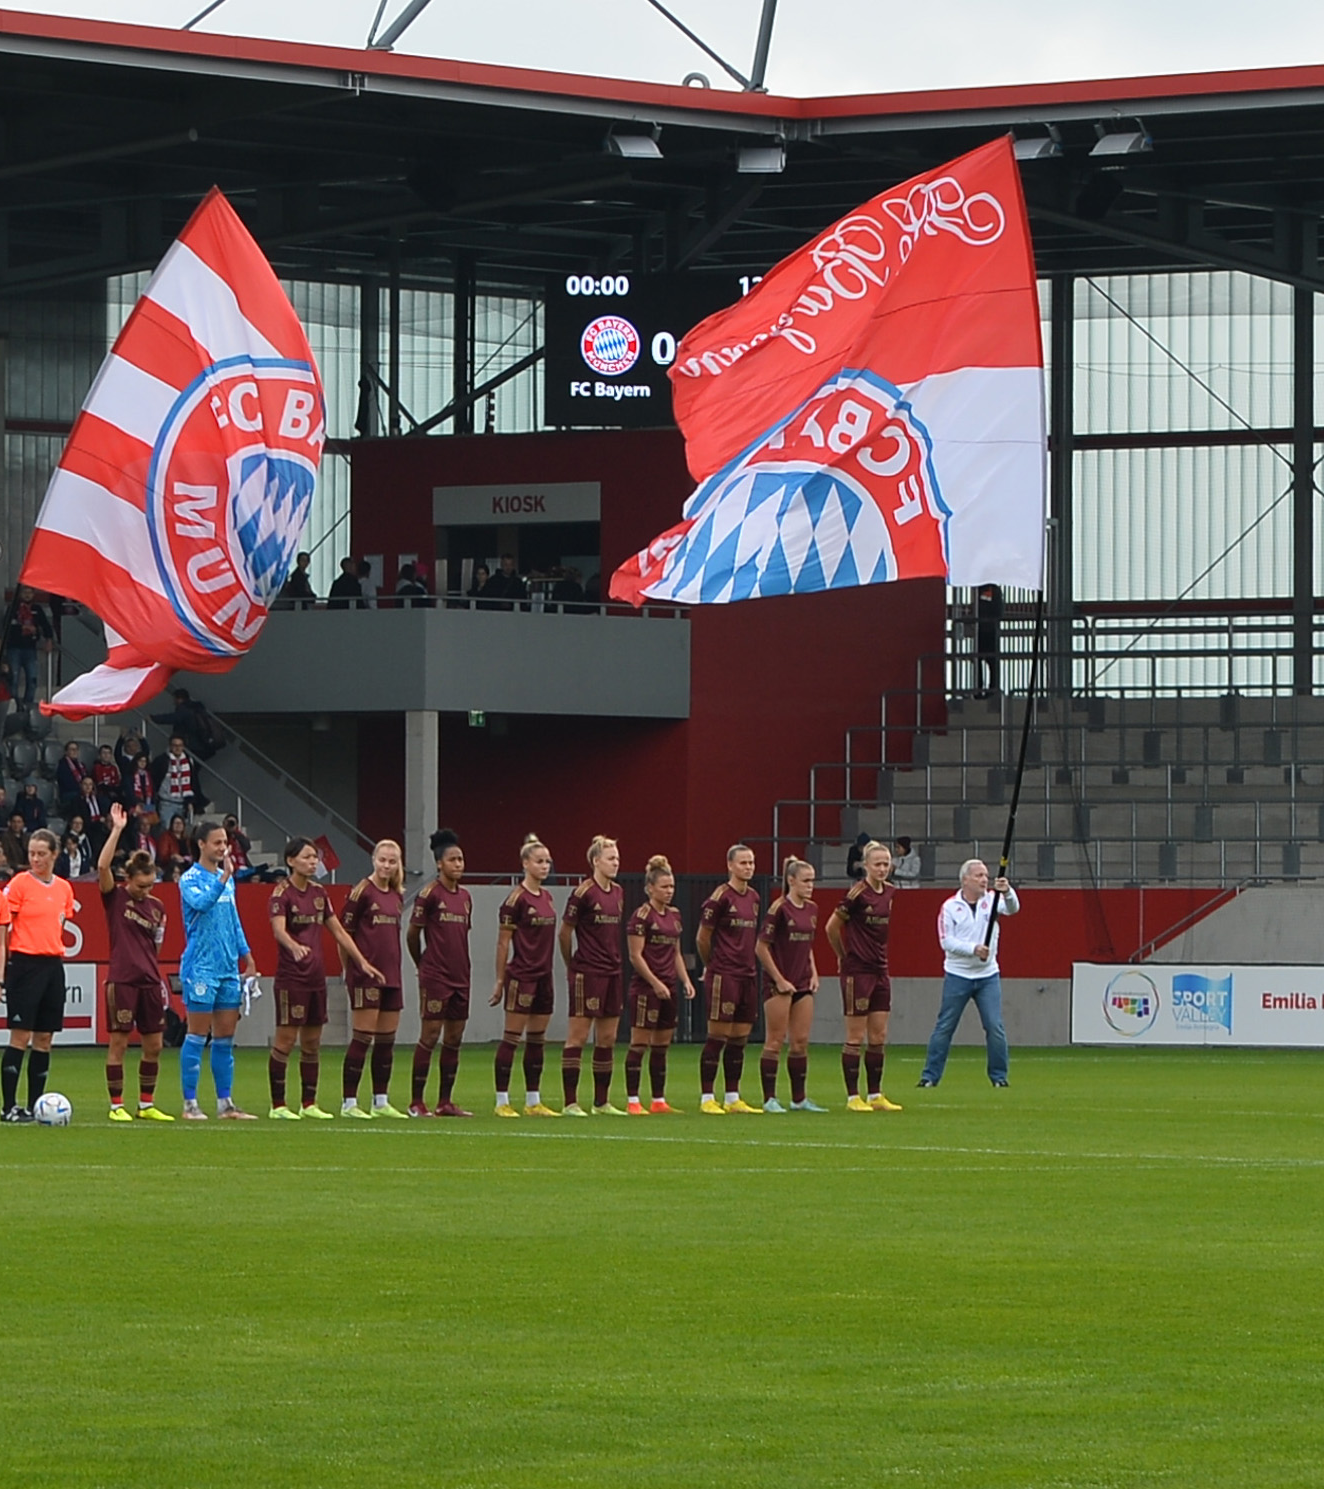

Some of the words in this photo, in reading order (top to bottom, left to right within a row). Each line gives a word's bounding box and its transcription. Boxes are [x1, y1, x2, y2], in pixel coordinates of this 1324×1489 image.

[566, 275, 629, 296] 00:00
[570, 381, 591, 397] FC
[594, 381, 650, 401] Bayern
[492, 495, 546, 514] KIOSK
[1172, 991, 1229, 1007] SPORT
[1261, 992, 1317, 1010] Emilia
[1172, 1007, 1227, 1023] VALLEY
